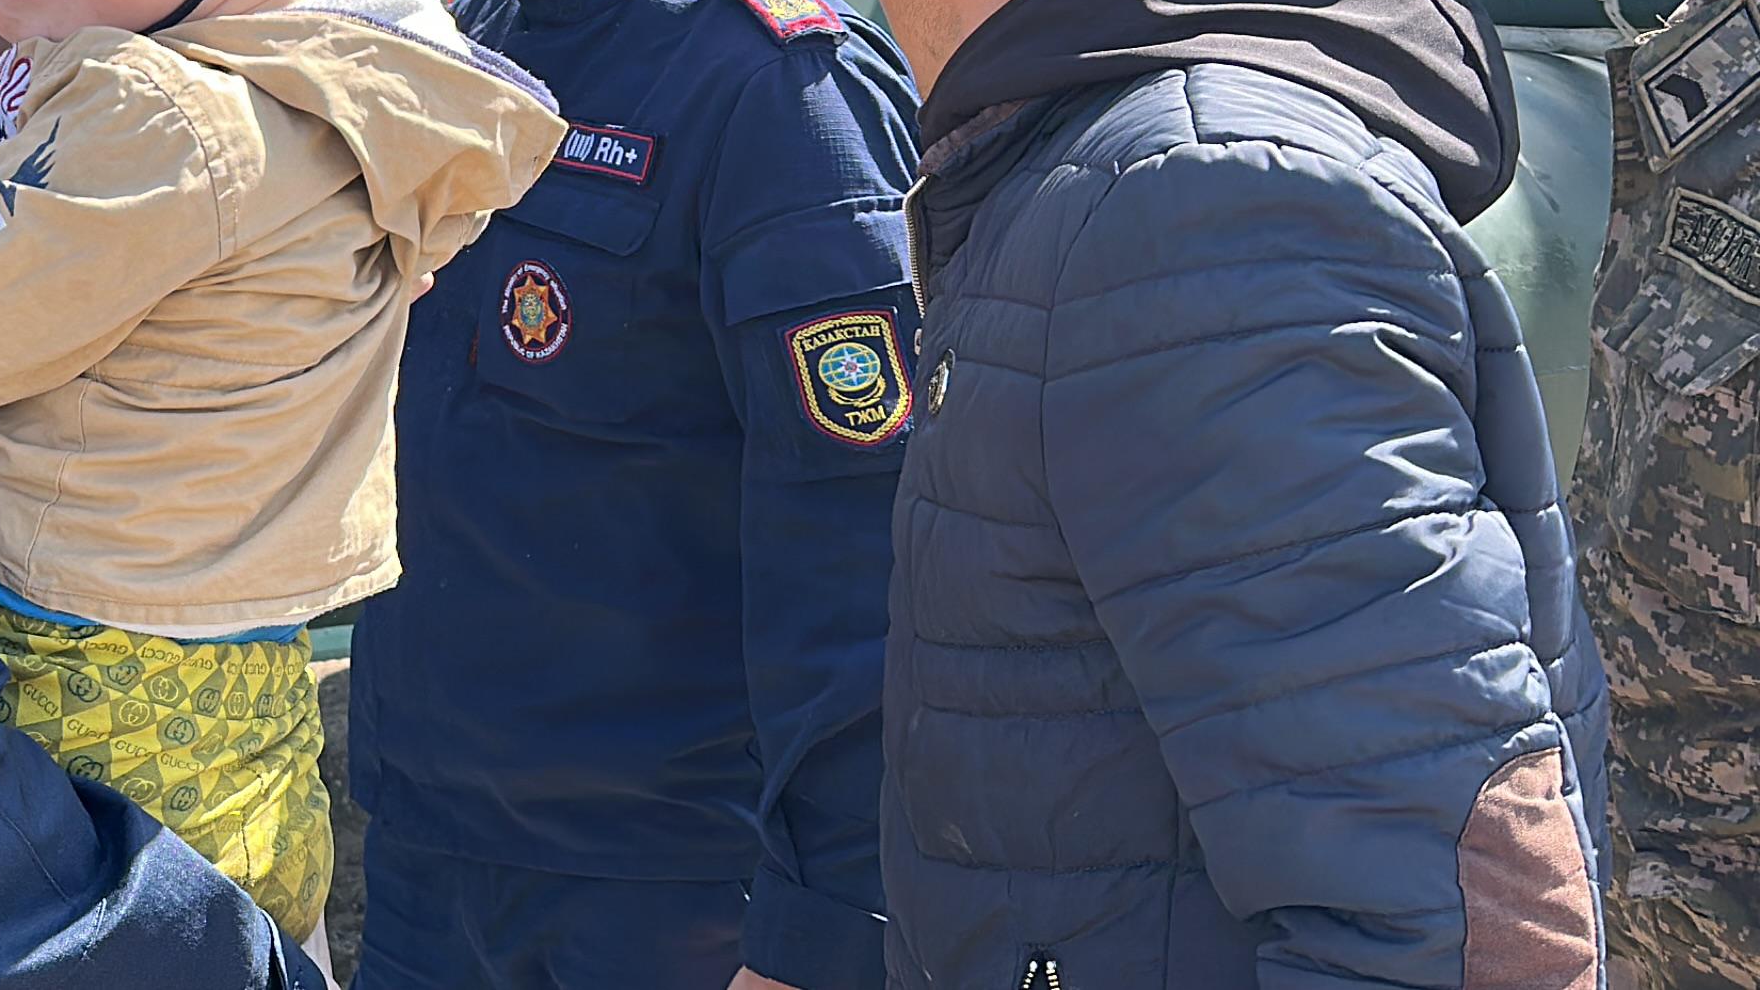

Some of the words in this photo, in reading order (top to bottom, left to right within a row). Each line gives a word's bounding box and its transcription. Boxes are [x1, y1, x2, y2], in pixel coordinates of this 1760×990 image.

[844, 404, 887, 427] ТЖМ
[23, 683, 60, 718] GUCCI
[160, 751, 201, 773] GUCCI
